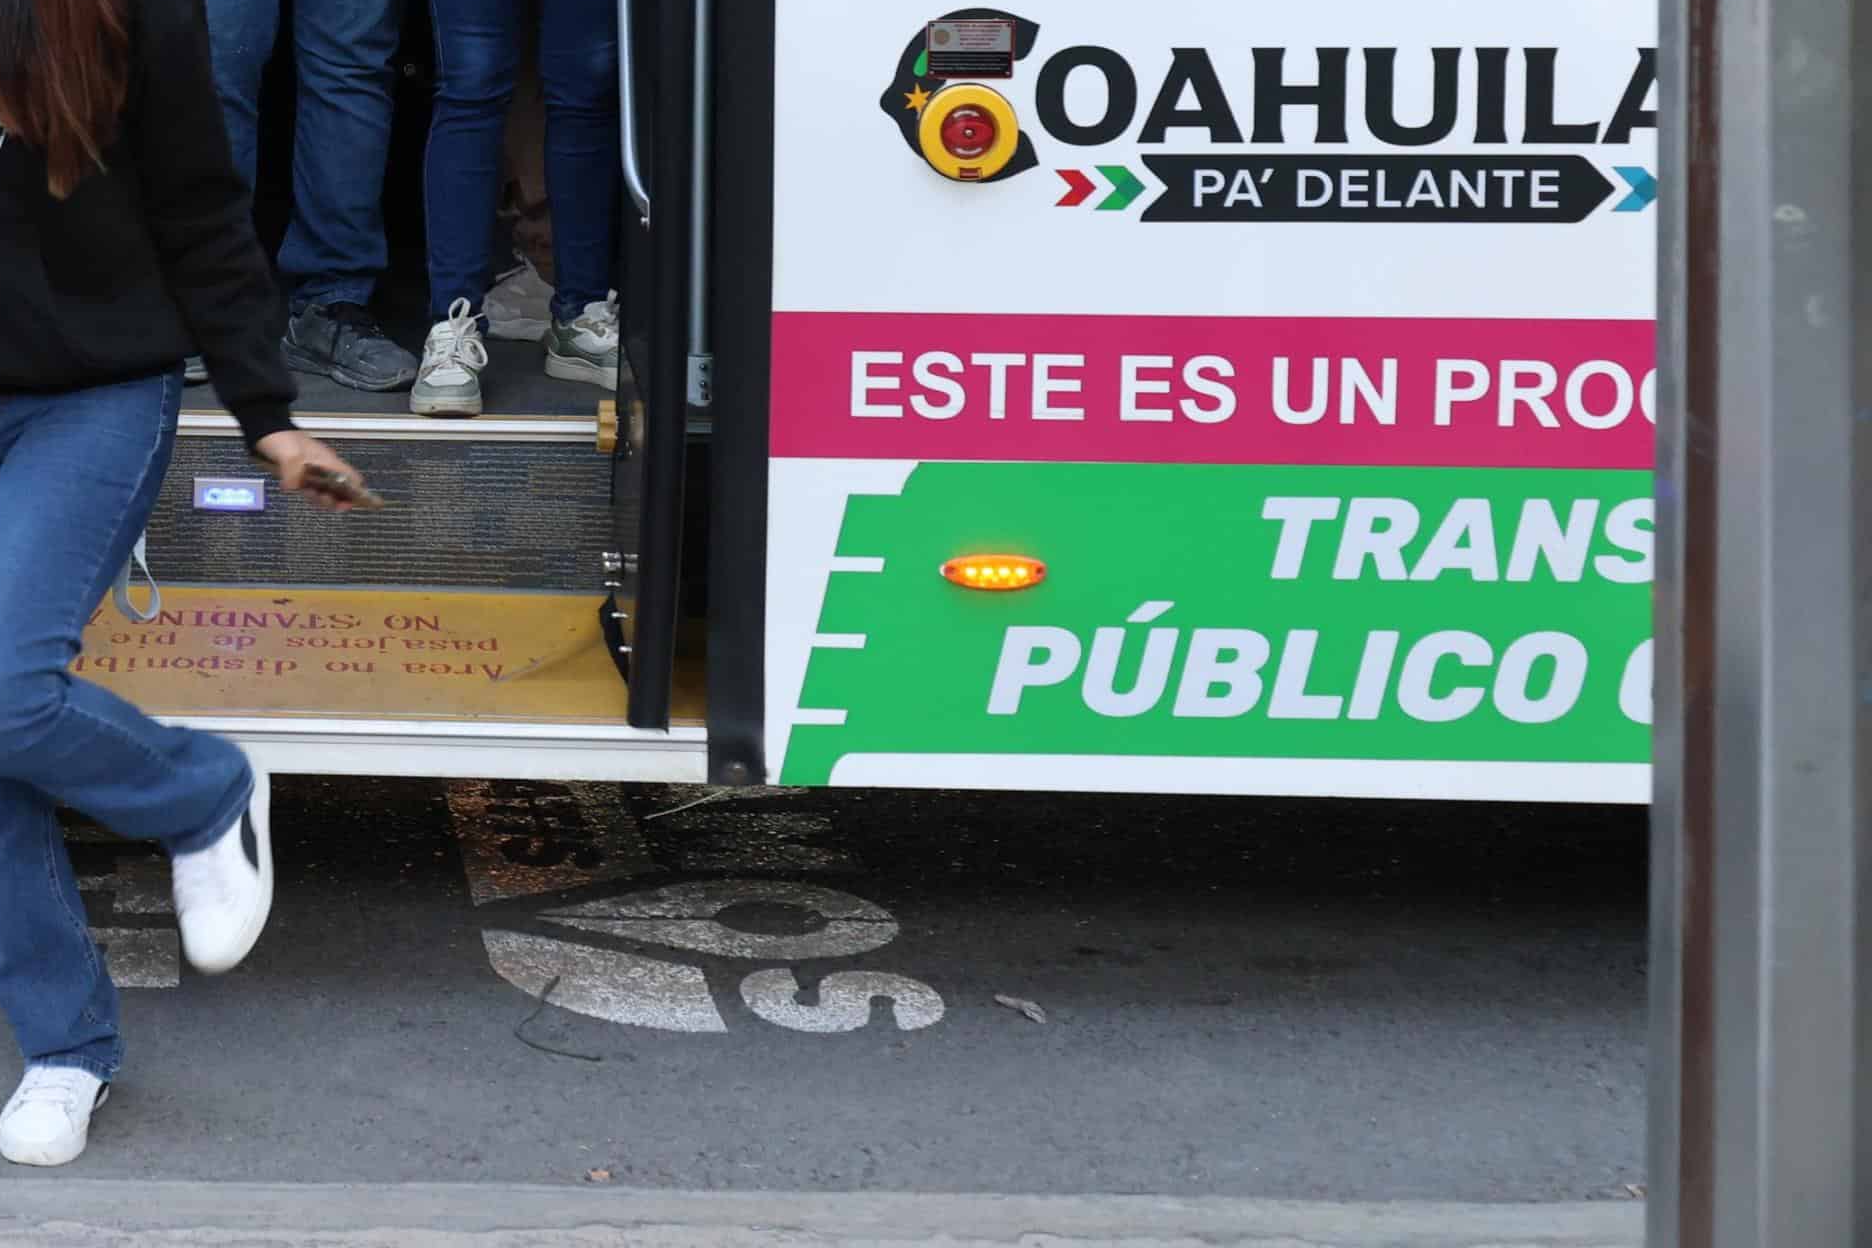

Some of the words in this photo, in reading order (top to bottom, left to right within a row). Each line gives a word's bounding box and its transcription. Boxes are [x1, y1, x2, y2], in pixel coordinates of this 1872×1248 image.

[1296, 169, 1560, 209] DELANTE
[849, 350, 1086, 422] ESTE
[1120, 354, 1238, 425] ES
[1271, 356, 1398, 426] UN
[1433, 358, 1656, 430] PRO
[1261, 496, 1656, 584] TRANS
[383, 614, 441, 632] NO
[110, 631, 177, 649] pie
[213, 633, 257, 651] de
[286, 636, 499, 654] pasajeros
[325, 660, 377, 674] no
[986, 600, 1589, 725] PÚBLICO
